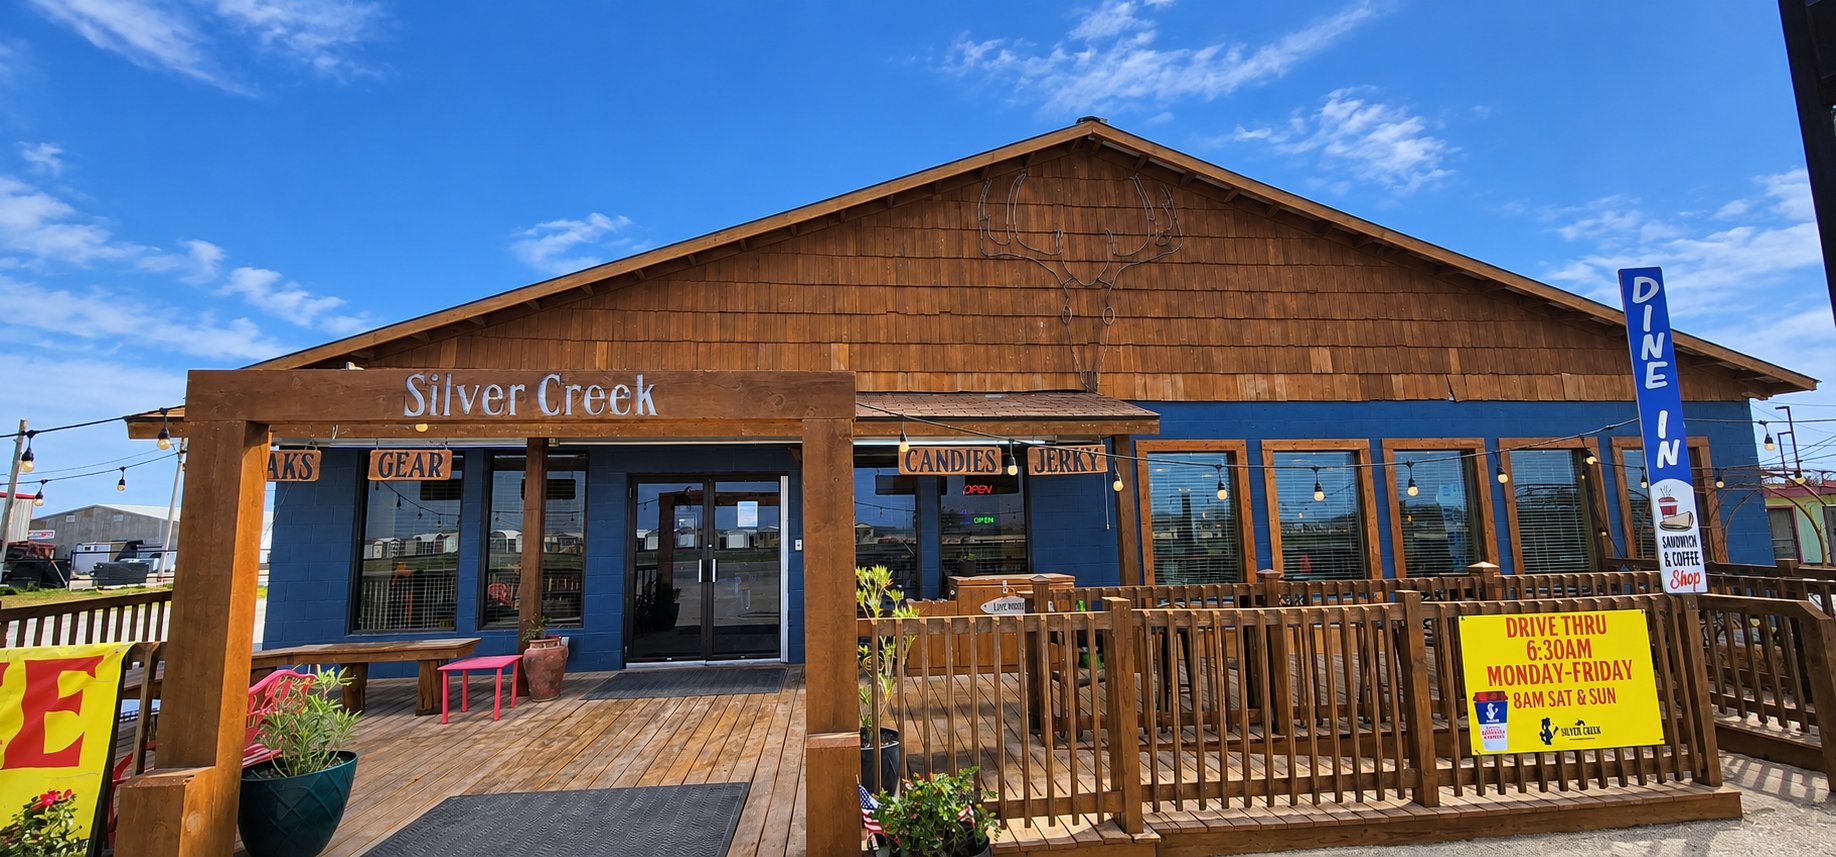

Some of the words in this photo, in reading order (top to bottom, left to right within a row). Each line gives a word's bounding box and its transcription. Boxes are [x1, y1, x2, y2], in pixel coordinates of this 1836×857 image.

[1632, 276, 1668, 390] DINE
[1656, 410, 1681, 469] IN
[403, 372, 526, 416] Silver
[537, 373, 659, 416] Creek
[267, 452, 315, 480] AKS
[378, 451, 444, 478] GEAR
[905, 449, 997, 473] CANDIES
[1034, 447, 1099, 473] JERKY
[963, 484, 993, 495] OPEN
[973, 516, 994, 524] OPEN
[1662, 535, 1697, 548] SANDWICH
[1664, 551, 1671, 567] &
[1672, 551, 1700, 566] COFFEE
[1670, 569, 1701, 592] Shop
[1505, 616, 1559, 638] DRIVE
[1561, 614, 1607, 636] THRU
[1526, 638, 1592, 661] 6:30AM
[1487, 659, 1633, 687] MONDAY-FRIDAY
[1513, 691, 1545, 709] 8AM
[1548, 689, 1573, 707] SAT
[1576, 689, 1587, 705] &
[1588, 687, 1617, 705] SUN
[0, 655, 104, 770] E
